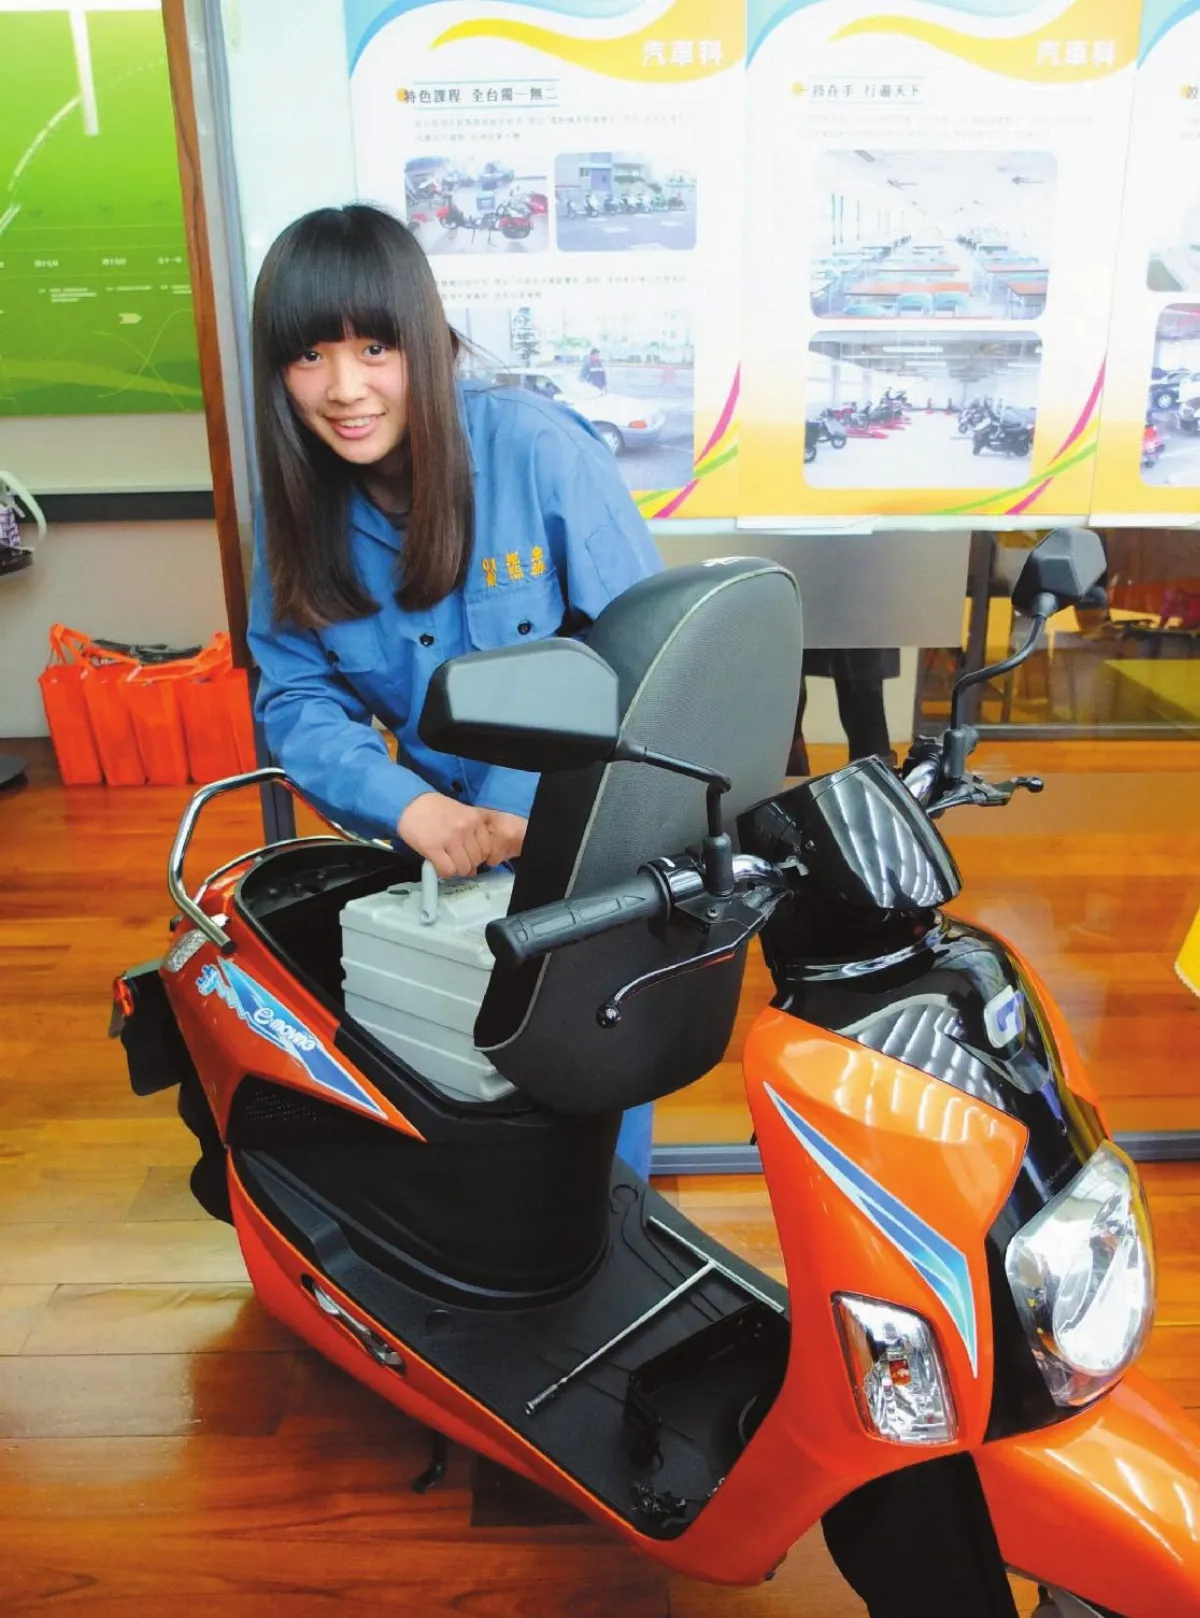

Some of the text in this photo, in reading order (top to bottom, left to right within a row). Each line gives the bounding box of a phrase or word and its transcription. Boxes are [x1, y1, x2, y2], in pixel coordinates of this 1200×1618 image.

[643, 38, 722, 67] 汽車科
[1035, 39, 1115, 67] 汽車科
[404, 87, 558, 104] 特色課程 全台獨一無二
